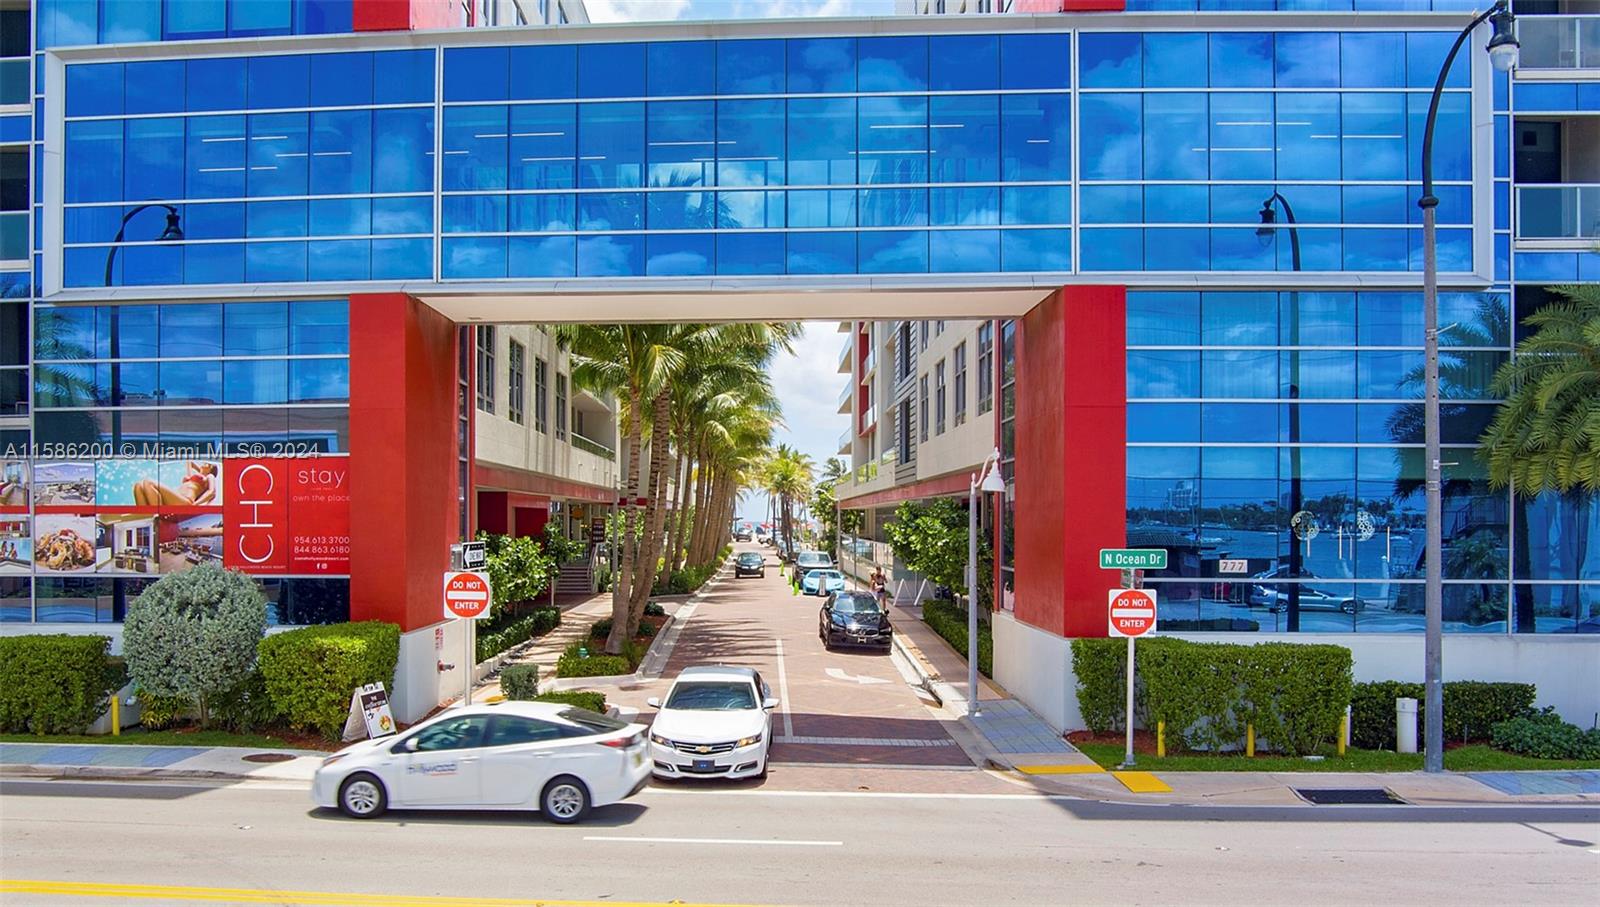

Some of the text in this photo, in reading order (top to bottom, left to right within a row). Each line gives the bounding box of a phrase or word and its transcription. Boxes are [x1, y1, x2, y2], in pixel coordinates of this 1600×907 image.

[298, 468, 345, 488] stay
[312, 494, 325, 502] the
[294, 536, 350, 544] 954.613.3700
[1105, 553, 1161, 564] N Ocean Dr
[1222, 561, 1244, 571] 777
[453, 581, 481, 589] DO NOT
[1117, 598, 1148, 607] DO NOT
